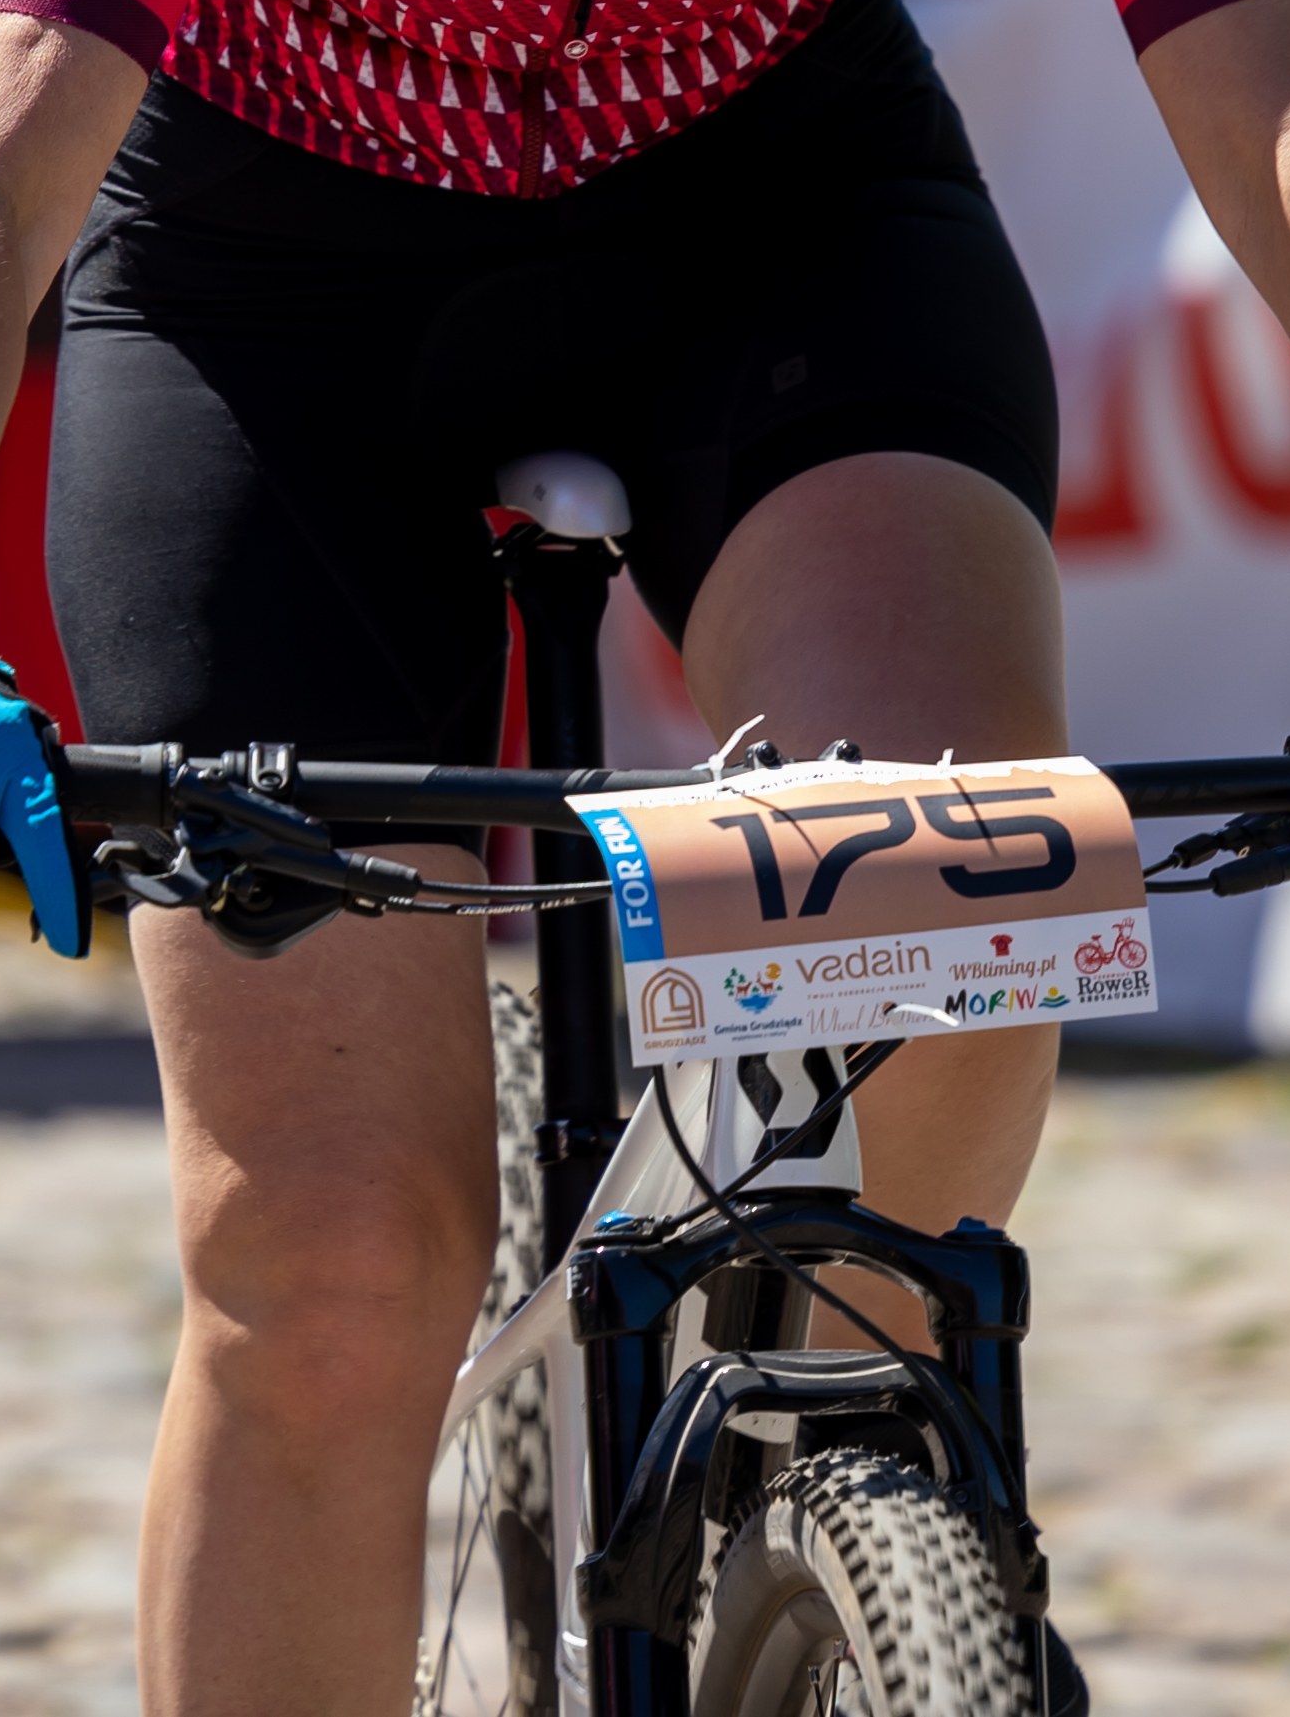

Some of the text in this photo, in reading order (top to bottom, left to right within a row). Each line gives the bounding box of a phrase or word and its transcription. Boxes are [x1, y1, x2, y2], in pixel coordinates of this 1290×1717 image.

[594, 816, 654, 929] FOR FUN
[709, 786, 1077, 922] 175
[795, 940, 932, 984] vadain
[948, 954, 1057, 982] WBtiming.pl
[714, 1021, 748, 1035] Gmina
[806, 1004, 865, 1035] Wheel
